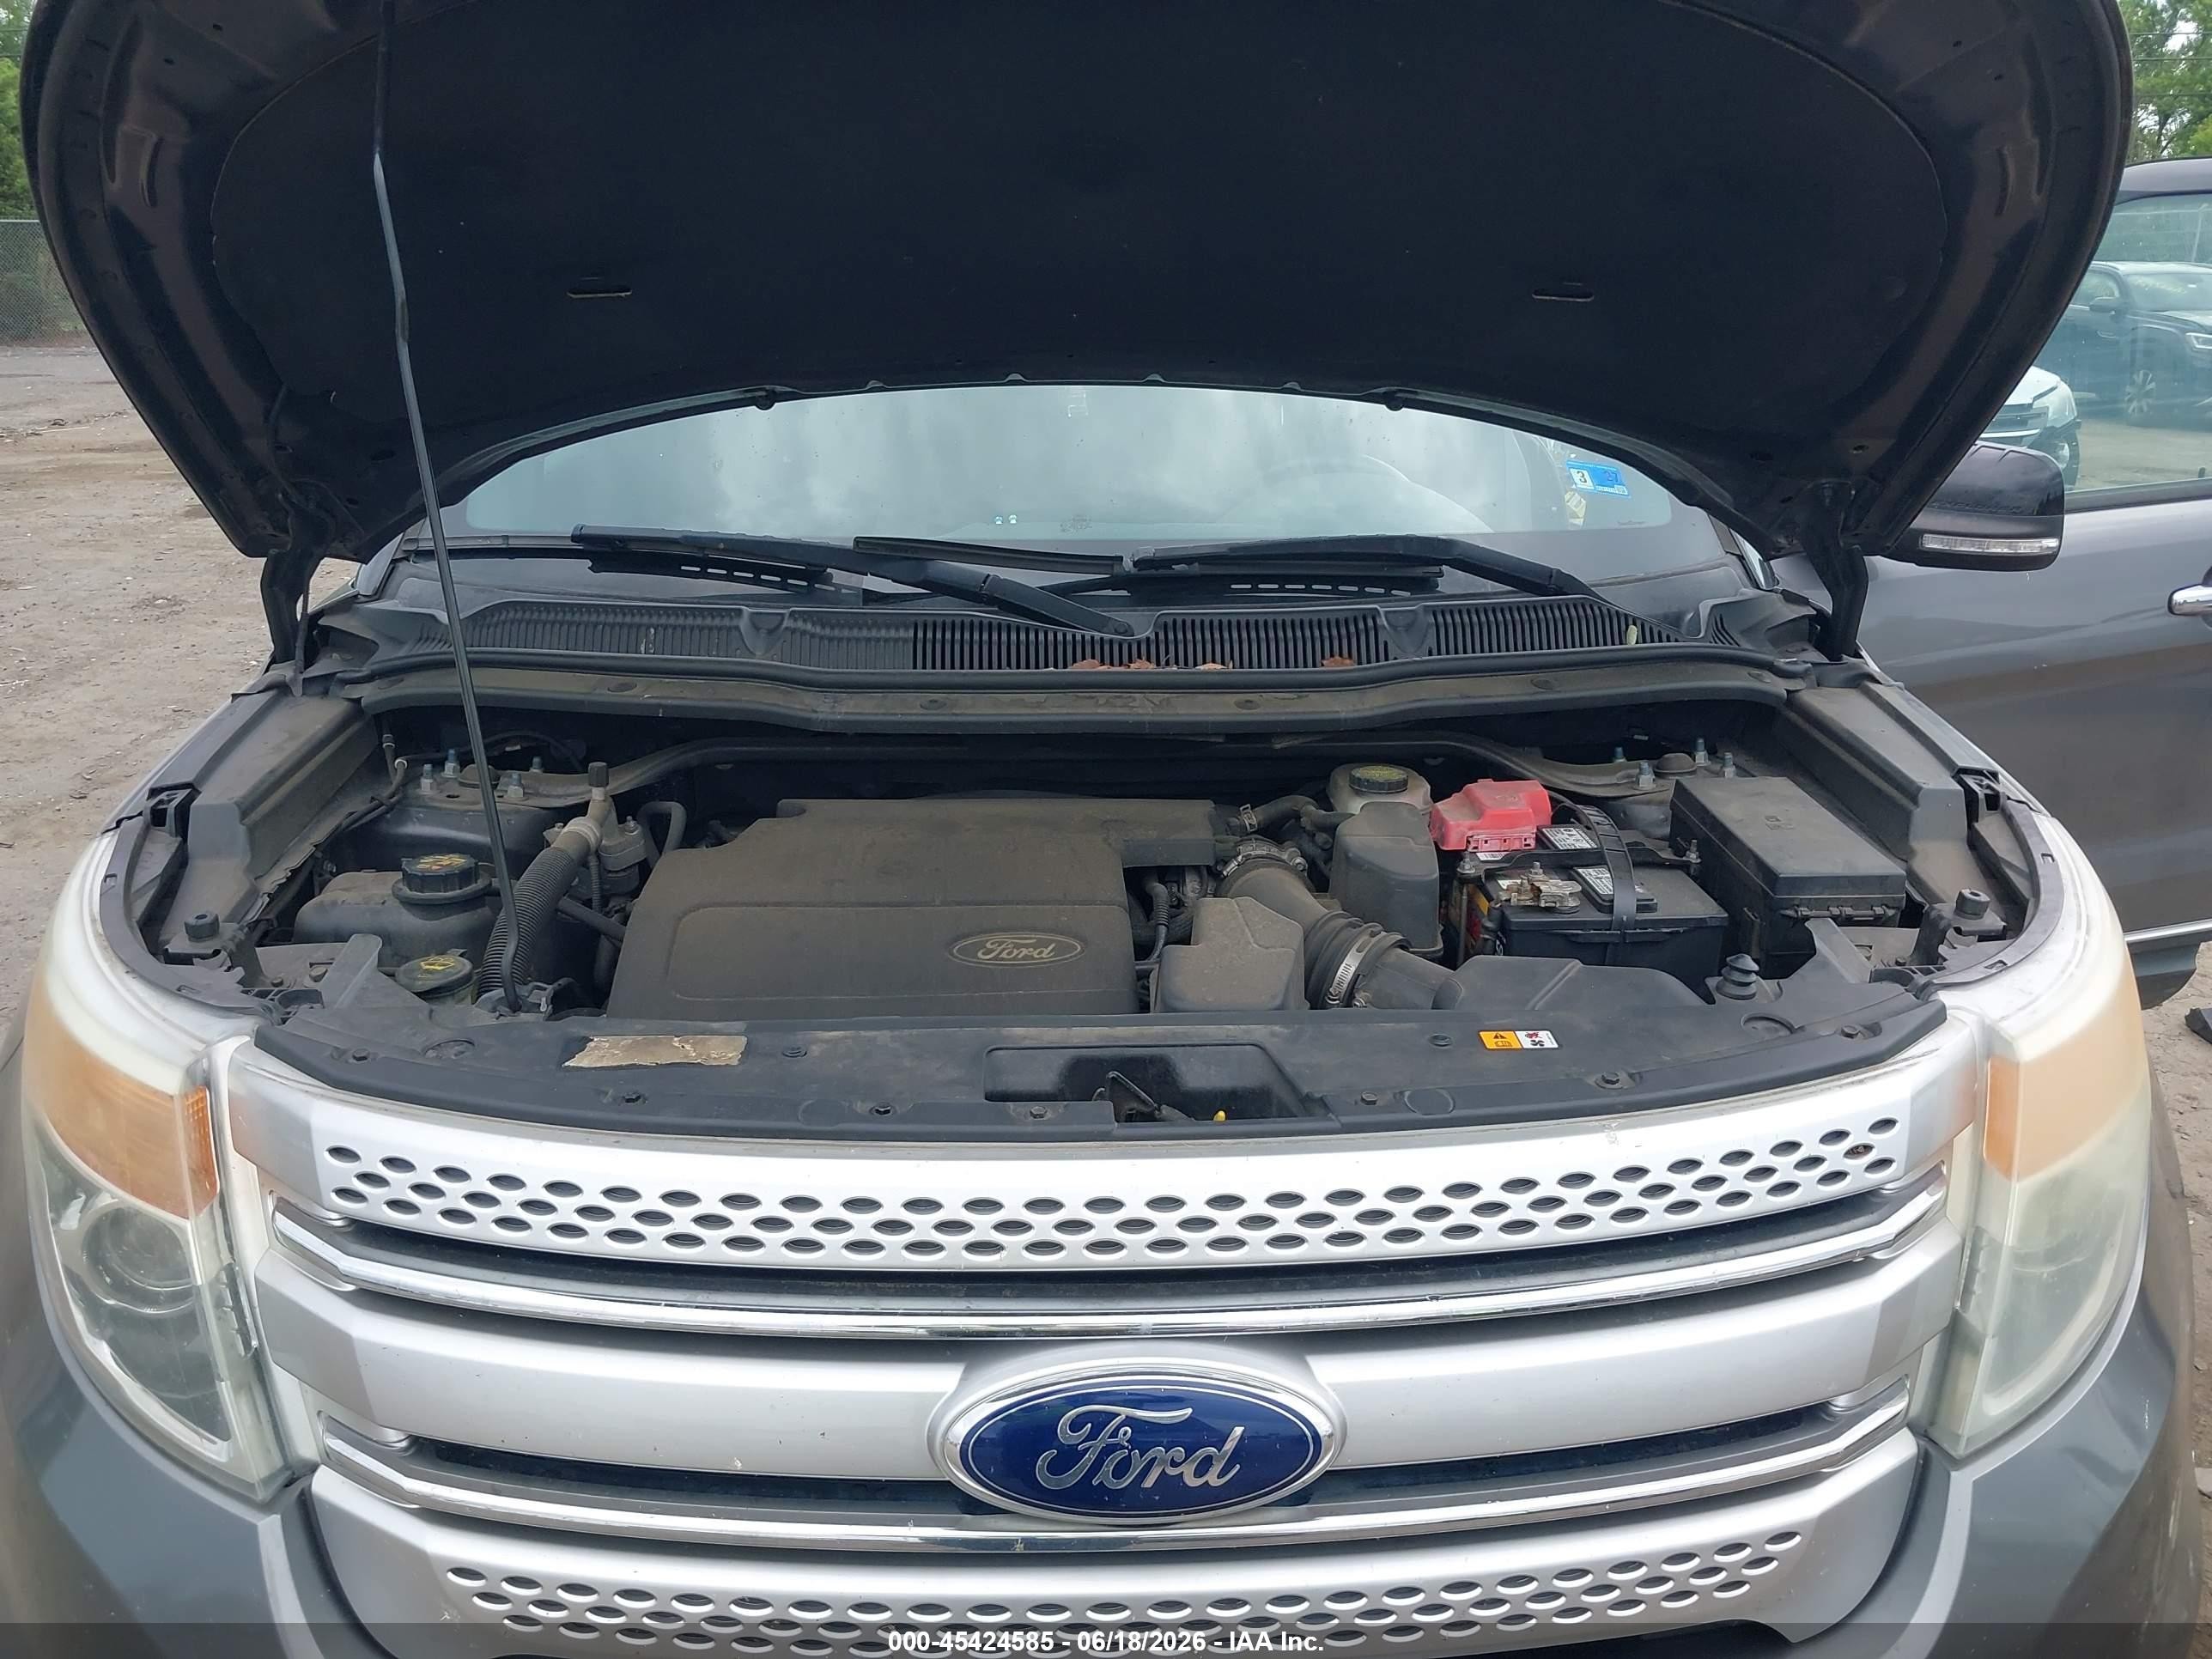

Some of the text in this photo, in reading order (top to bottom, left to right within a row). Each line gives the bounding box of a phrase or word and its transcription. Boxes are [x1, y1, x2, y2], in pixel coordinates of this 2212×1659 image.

[1576, 470, 1588, 483] 3
[977, 939, 1056, 959] Ford
[1035, 1404, 1245, 1491] Ford
